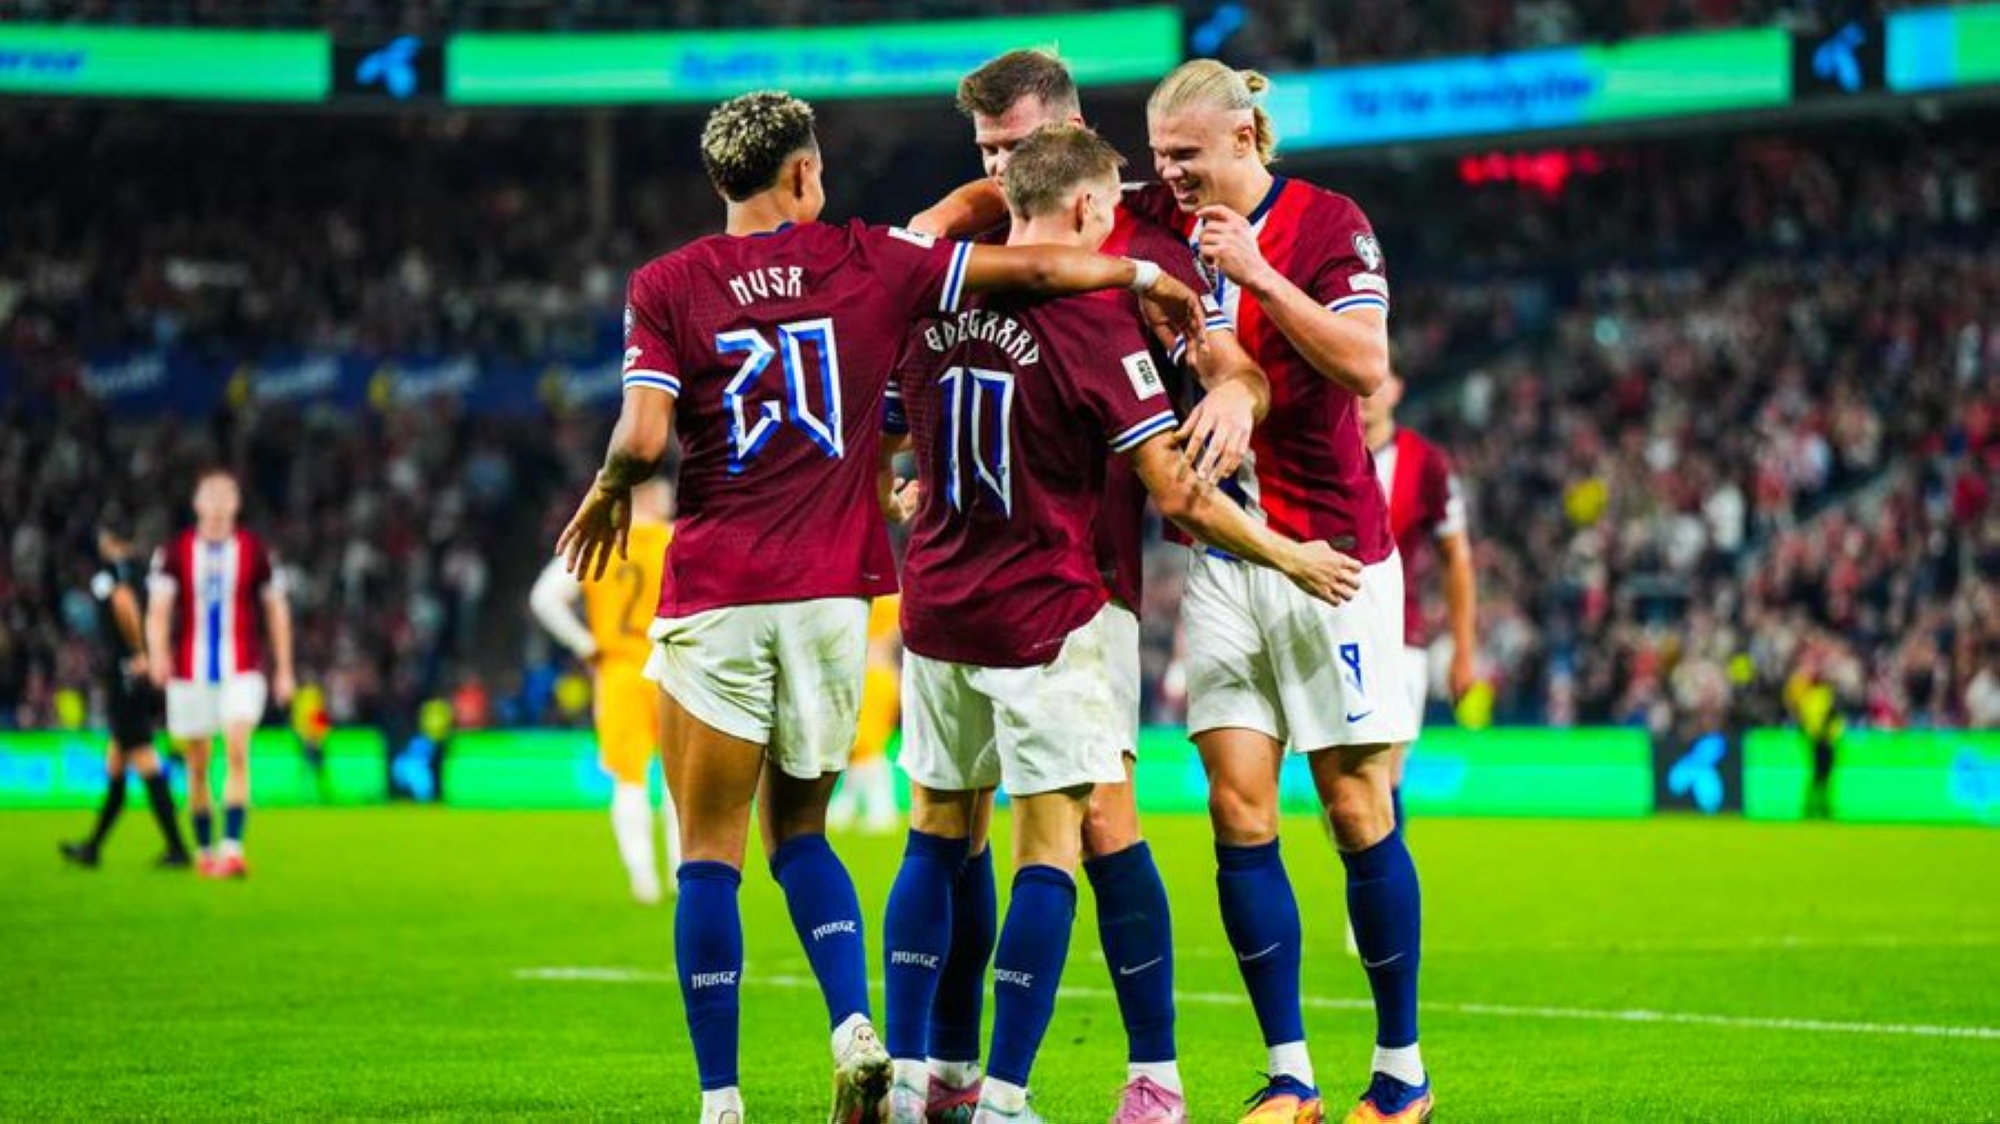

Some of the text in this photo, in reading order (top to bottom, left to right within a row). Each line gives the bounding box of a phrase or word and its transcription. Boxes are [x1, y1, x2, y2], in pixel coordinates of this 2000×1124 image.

[715, 317, 844, 477] 20
[937, 366, 1015, 519] 10
[614, 561, 646, 635] 2
[811, 919, 857, 942] NORGE
[691, 970, 738, 990] NORGE
[891, 950, 939, 969] NORGE
